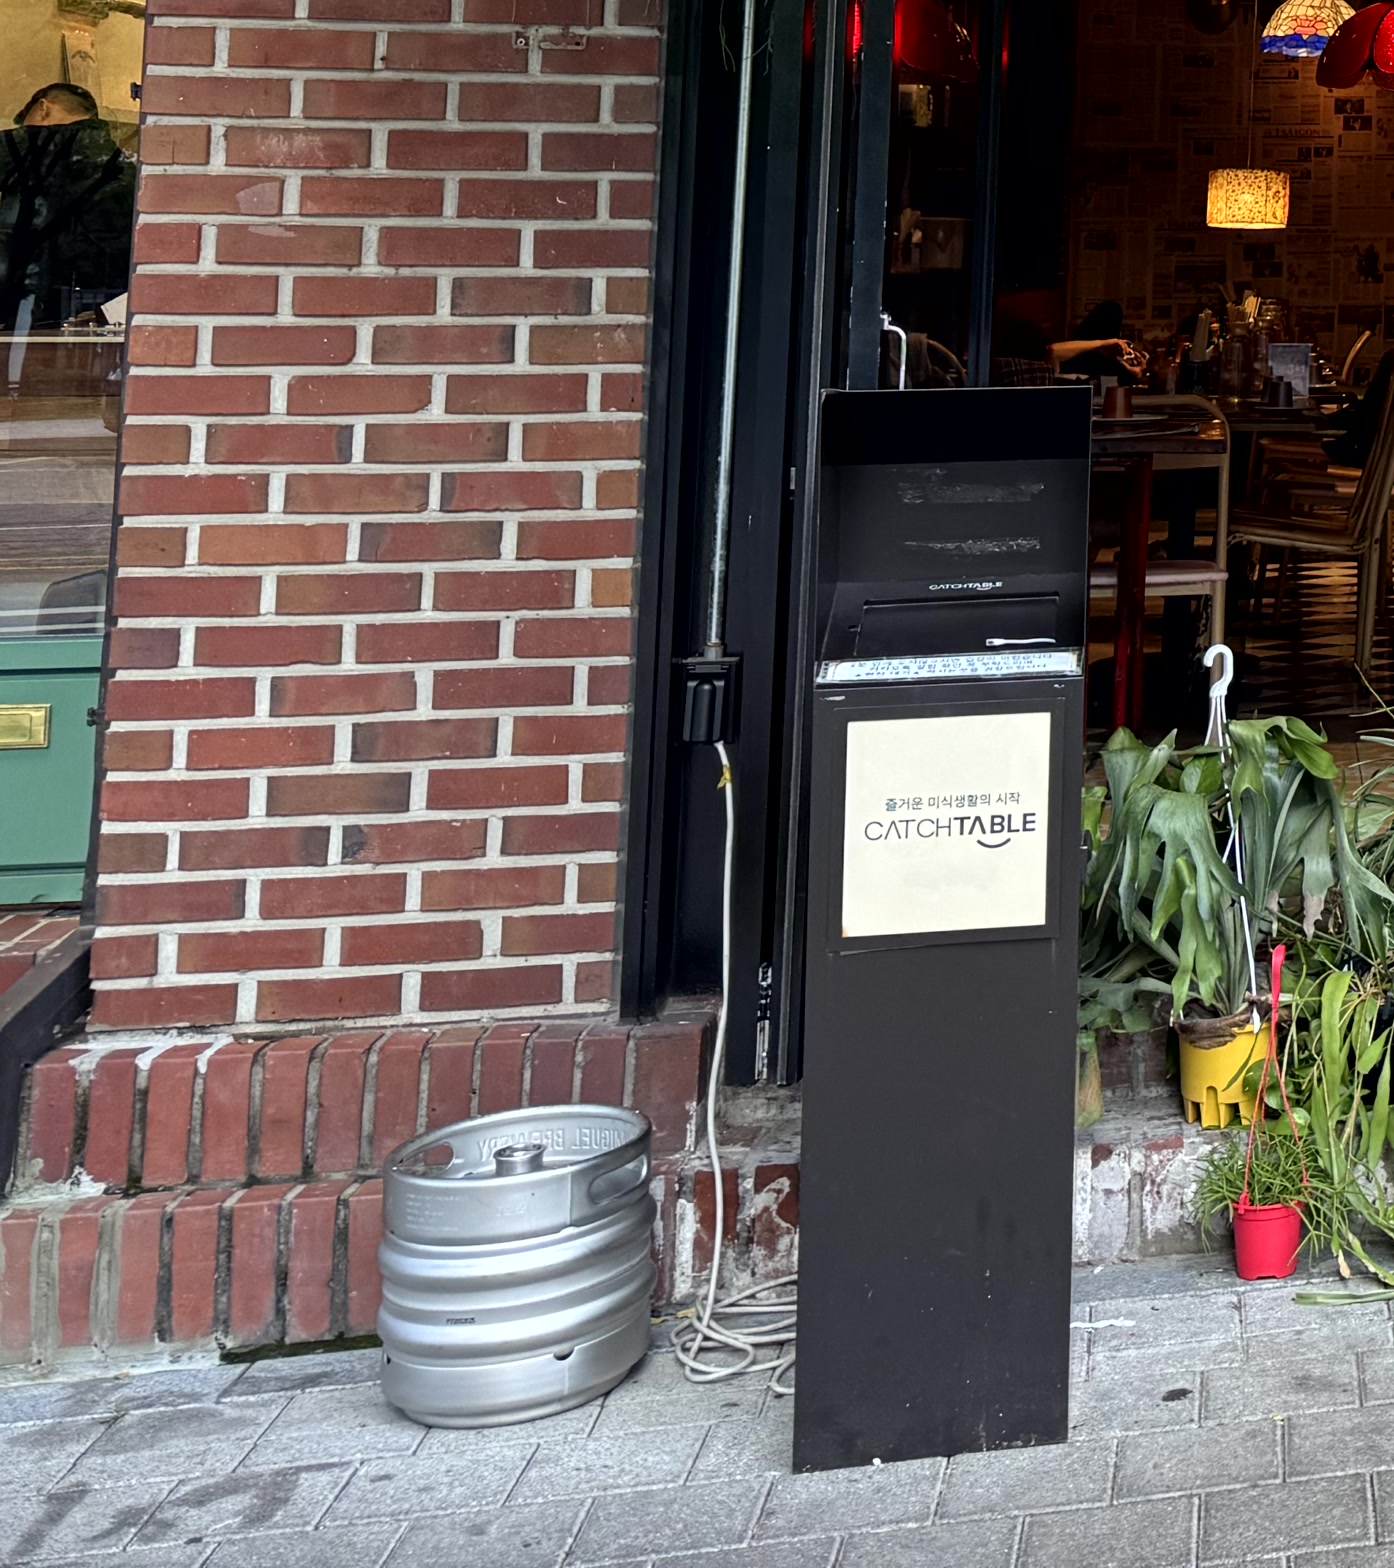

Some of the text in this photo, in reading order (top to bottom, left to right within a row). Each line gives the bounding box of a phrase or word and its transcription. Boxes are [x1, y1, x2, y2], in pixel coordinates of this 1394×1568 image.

[928, 581, 1003, 591] CATCHTABLE
[885, 791, 1021, 812] 즐거운 미식생활의 시작
[864, 812, 1037, 842] CATCHTABLE
